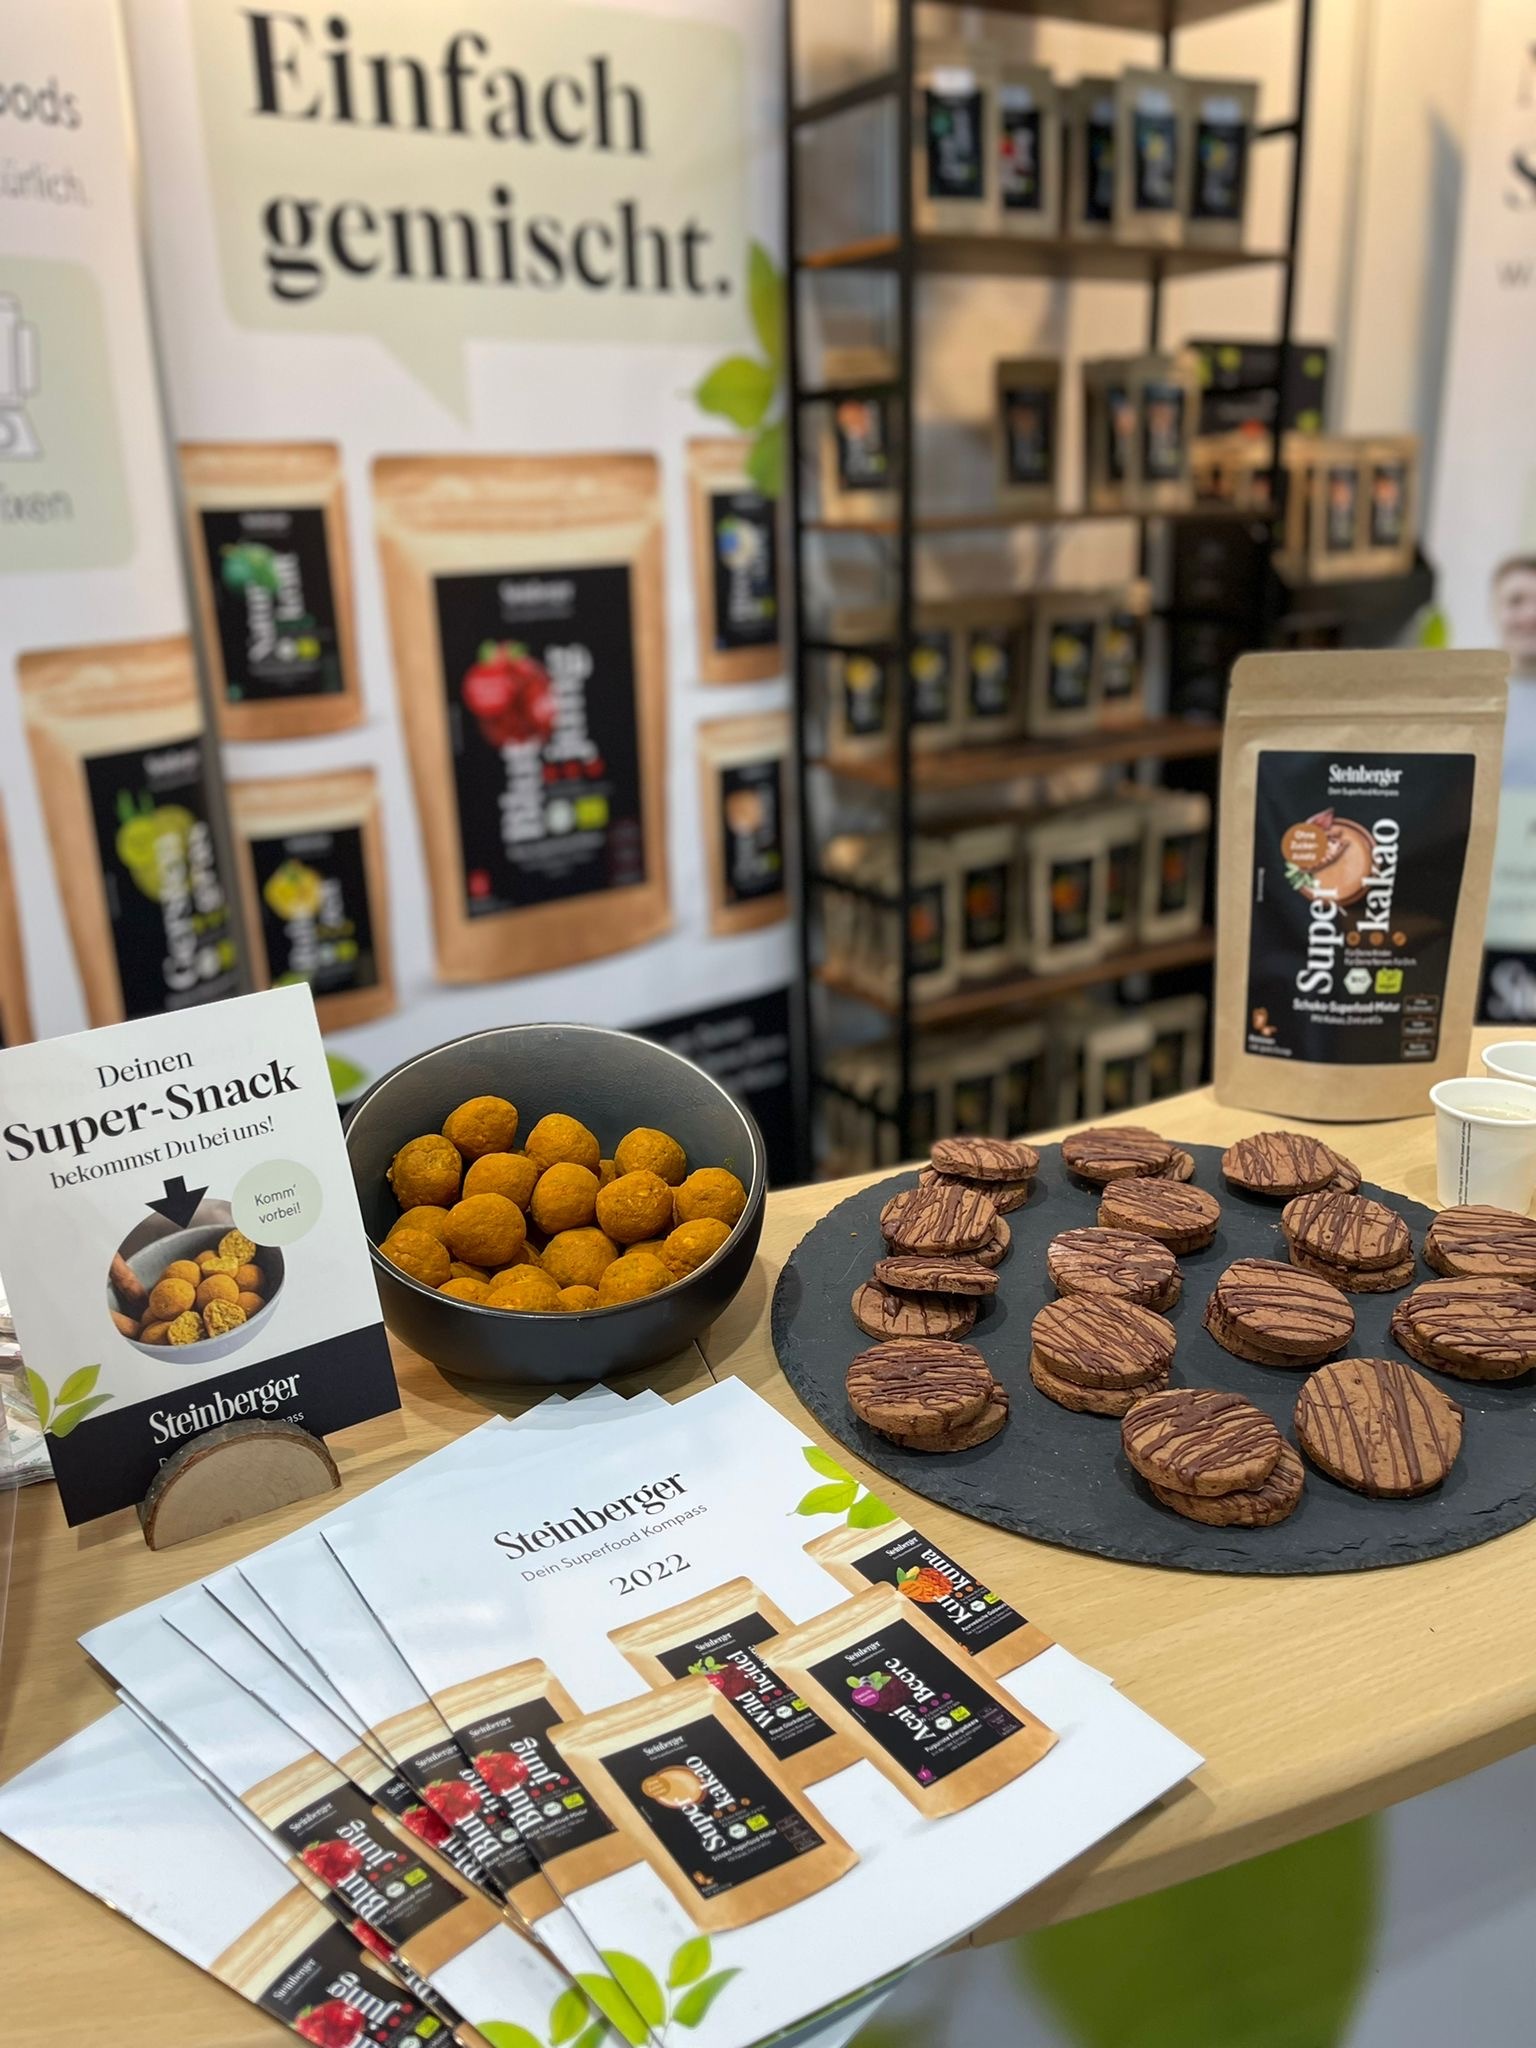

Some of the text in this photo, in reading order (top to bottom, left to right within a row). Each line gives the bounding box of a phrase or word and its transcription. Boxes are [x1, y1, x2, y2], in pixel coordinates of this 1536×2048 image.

[242, 7, 648, 156] Einfach
[262, 187, 733, 304] gemischt.
[1328, 763, 1403, 786] Steinberger
[1357, 818, 1400, 933] kakao
[1296, 880, 1344, 994] Super
[95, 1050, 194, 1089] Deinen
[2, 1059, 302, 1162] Super-Snack
[49, 1115, 275, 1190] bekommst Du bei uns!
[258, 1201, 301, 1225] vorbei!
[149, 1373, 301, 1445] Steinberger
[493, 1472, 688, 1560] Steinberger
[520, 1502, 709, 1583] Dein Superfood Kompass
[608, 1552, 692, 1596] 2022
[932, 1594, 973, 1625] Kur
[725, 1649, 777, 1695] heidel
[844, 1640, 881, 1663] Steinberger
[884, 1657, 936, 1704] Beere
[468, 1717, 512, 1738] Steinberger
[735, 1690, 775, 1729] Wild
[510, 1736, 562, 1787] jung
[642, 1735, 686, 1757] Steinberger
[501, 1783, 545, 1834] Blut
[685, 1755, 737, 1810] kakao
[336, 1818, 398, 1872] jung
[454, 1811, 503, 1861] Blut
[674, 1796, 728, 1852] Super
[336, 1868, 390, 1922] Blut
[325, 1969, 401, 2032] jung
